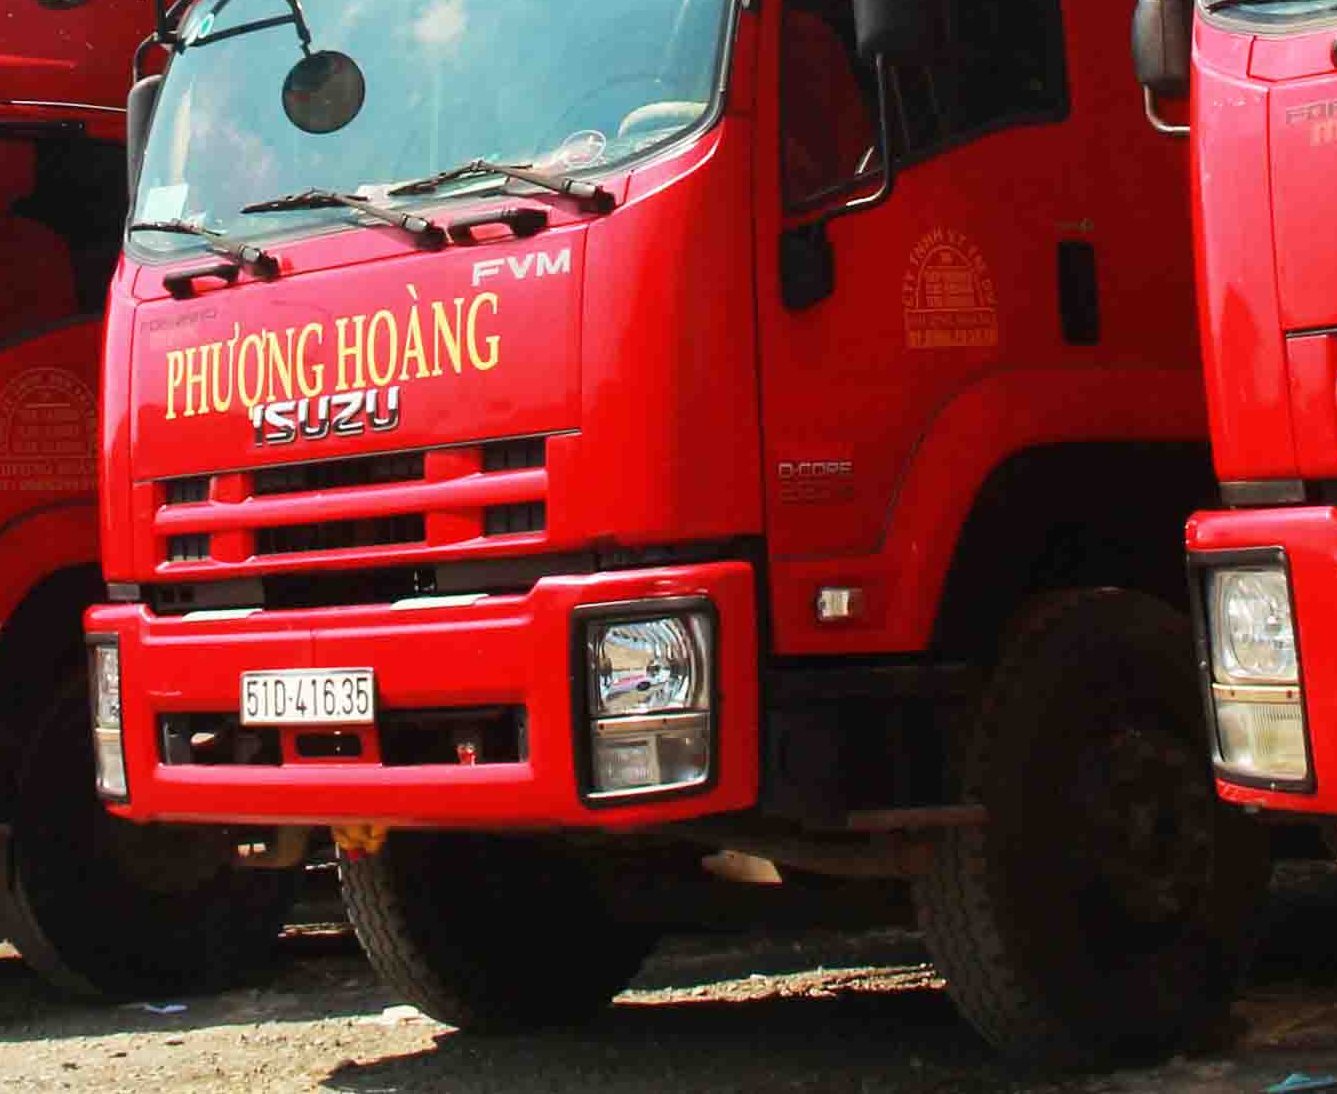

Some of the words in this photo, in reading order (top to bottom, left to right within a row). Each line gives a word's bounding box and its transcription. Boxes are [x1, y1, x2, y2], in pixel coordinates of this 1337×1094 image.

[471, 249, 571, 287] FVM
[335, 284, 501, 391] HOÀNG
[252, 386, 401, 447] ISUZU
[246, 677, 369, 717] 51D-416.35
